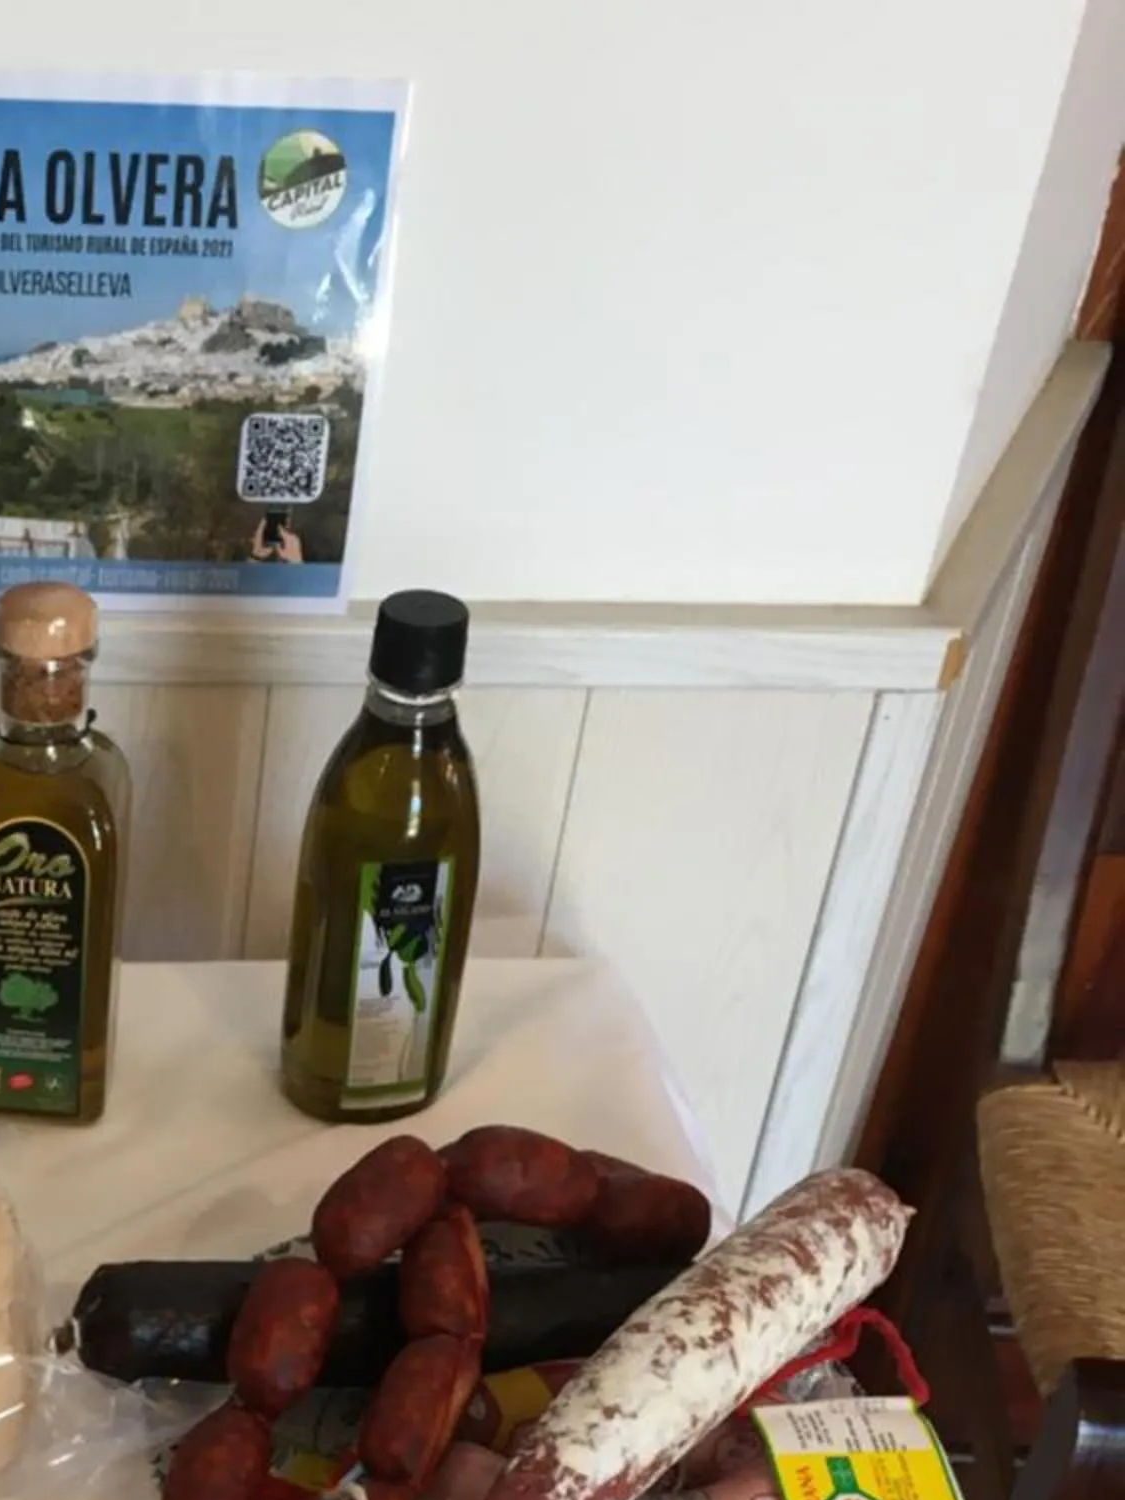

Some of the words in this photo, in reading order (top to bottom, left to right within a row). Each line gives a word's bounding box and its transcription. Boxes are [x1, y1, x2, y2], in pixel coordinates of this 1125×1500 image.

[45, 149, 238, 229] OLVERA
[268, 171, 342, 211] CAPITAL
[1, 233, 22, 250] DEL
[26, 234, 83, 254] TURISMO
[87, 235, 128, 255] RURAL
[130, 236, 146, 256] DE
[149, 235, 199, 257] ESPAÑA
[202, 240, 234, 258] 2021
